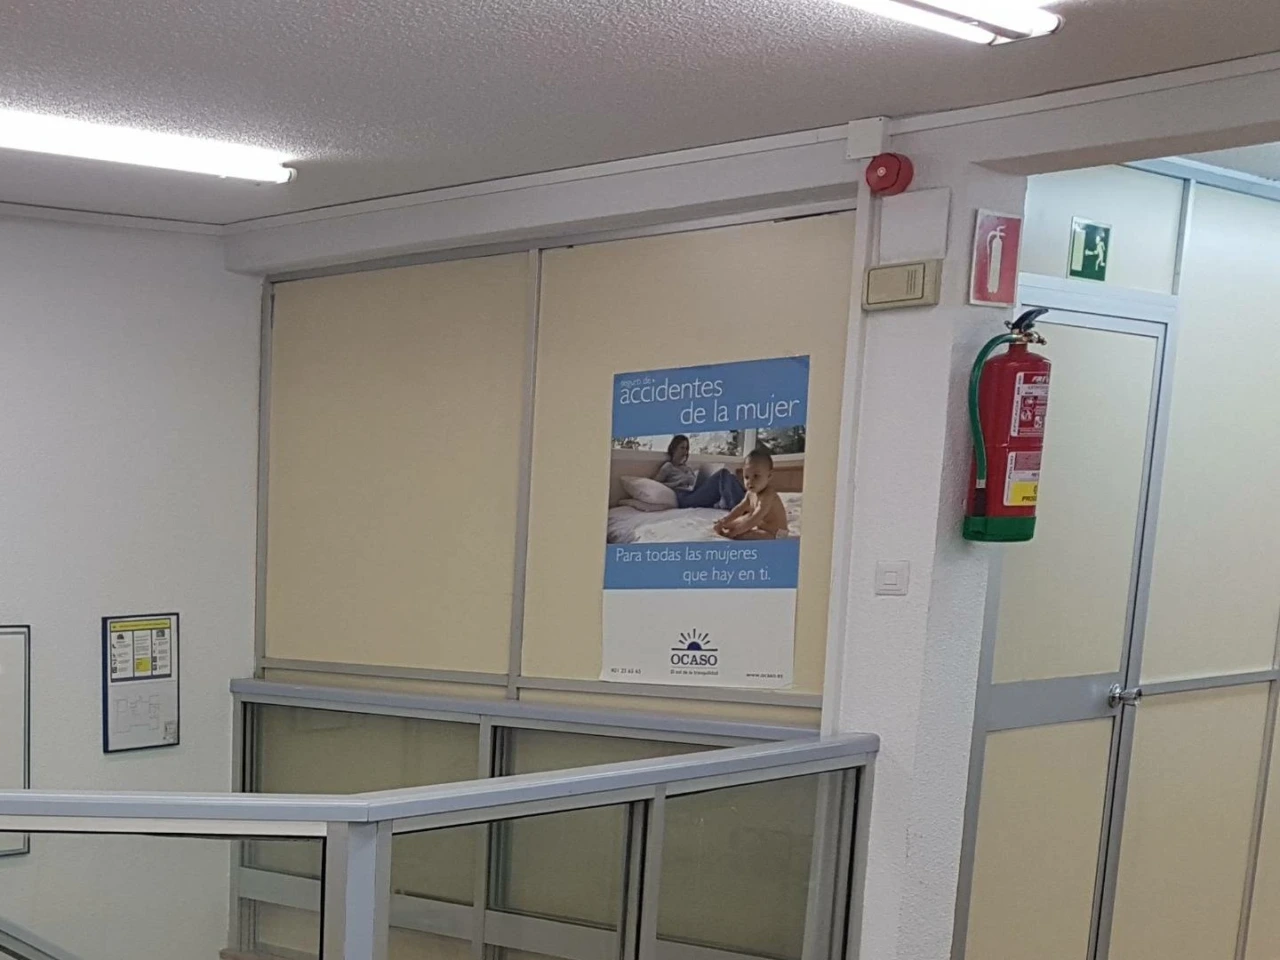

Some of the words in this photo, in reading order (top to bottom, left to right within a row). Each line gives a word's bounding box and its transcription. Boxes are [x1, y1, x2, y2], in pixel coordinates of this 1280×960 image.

[620, 378, 723, 405] accidentes
[680, 401, 706, 424] de
[713, 399, 729, 422] la
[736, 394, 800, 425] mujer
[616, 547, 642, 562] Para
[646, 547, 681, 562] todas
[685, 546, 702, 561] las
[705, 545, 758, 565] mujeres
[682, 568, 708, 583] que
[712, 567, 735, 584] hay
[738, 569, 755, 581] en
[759, 567, 771, 580] ti.
[670, 653, 718, 666] OCASO
